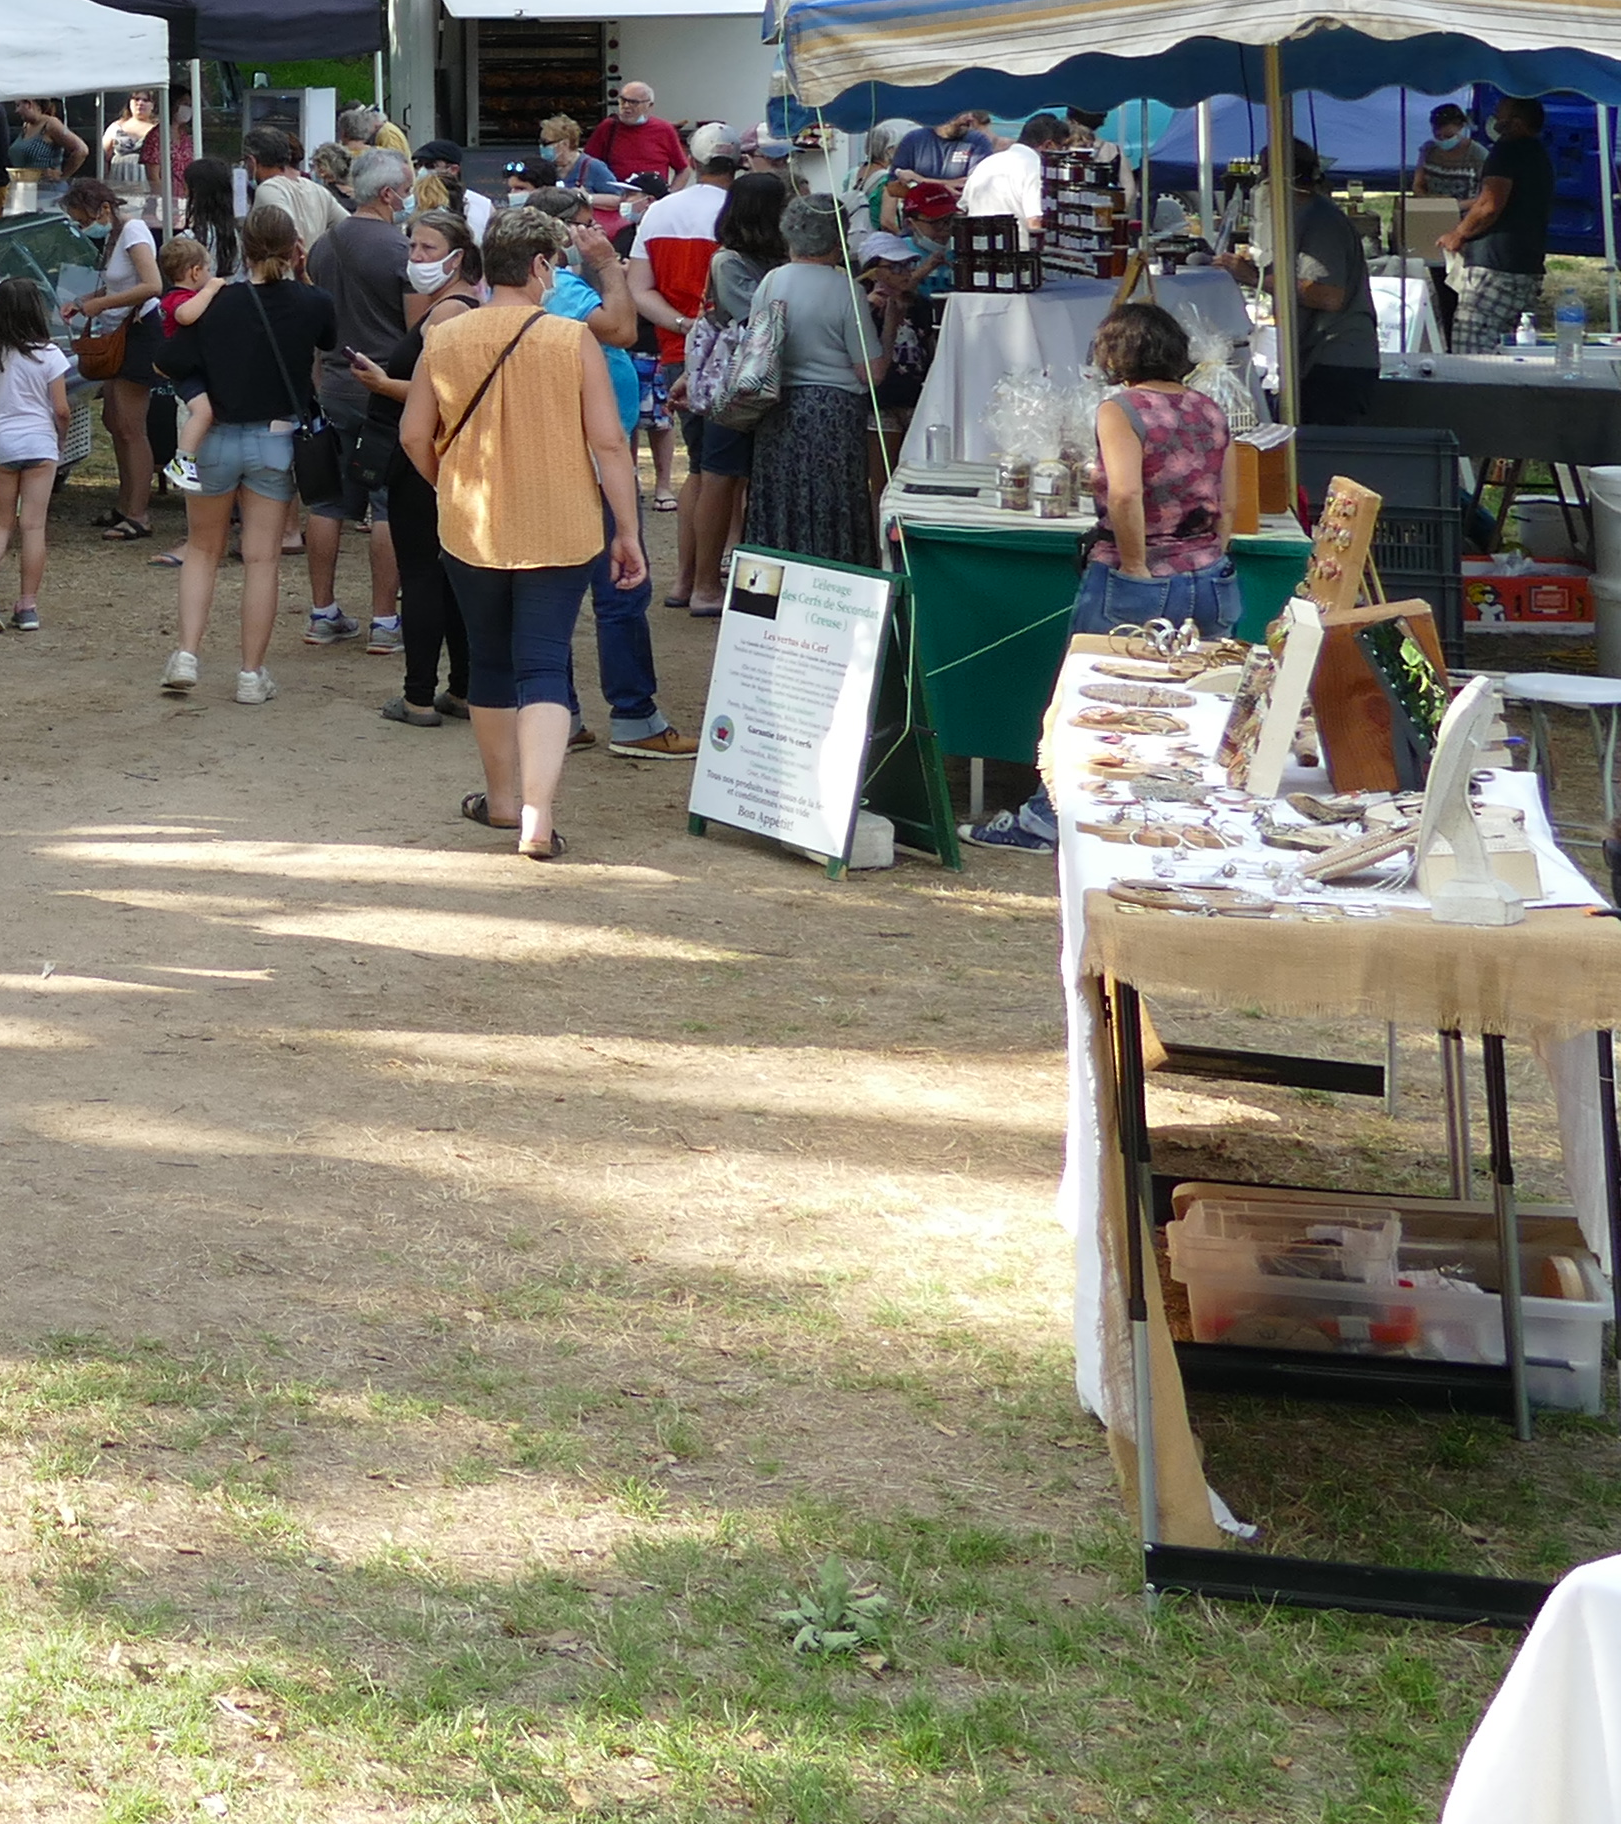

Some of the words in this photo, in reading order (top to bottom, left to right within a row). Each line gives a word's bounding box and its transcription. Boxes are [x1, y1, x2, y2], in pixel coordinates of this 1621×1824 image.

[812, 577, 852, 597] L'élevage
[782, 590, 797, 601] des
[798, 592, 822, 606] Cerfs
[823, 598, 835, 610] de
[837, 601, 879, 619] Secondat
[763, 630, 776, 641] Les
[777, 634, 799, 647] vertus
[800, 639, 810, 649] du
[811, 641, 829, 653] Cerf
[748, 725, 774, 738] Garantie
[707, 769, 721, 781] Tous
[722, 776, 734, 784] nos
[734, 777, 764, 794] produits
[764, 786, 779, 797] sont
[797, 794, 807, 806] de
[807, 797, 815, 808] la
[726, 787, 733, 795] et
[795, 805, 810, 818] vide
[737, 805, 755, 820] Bon
